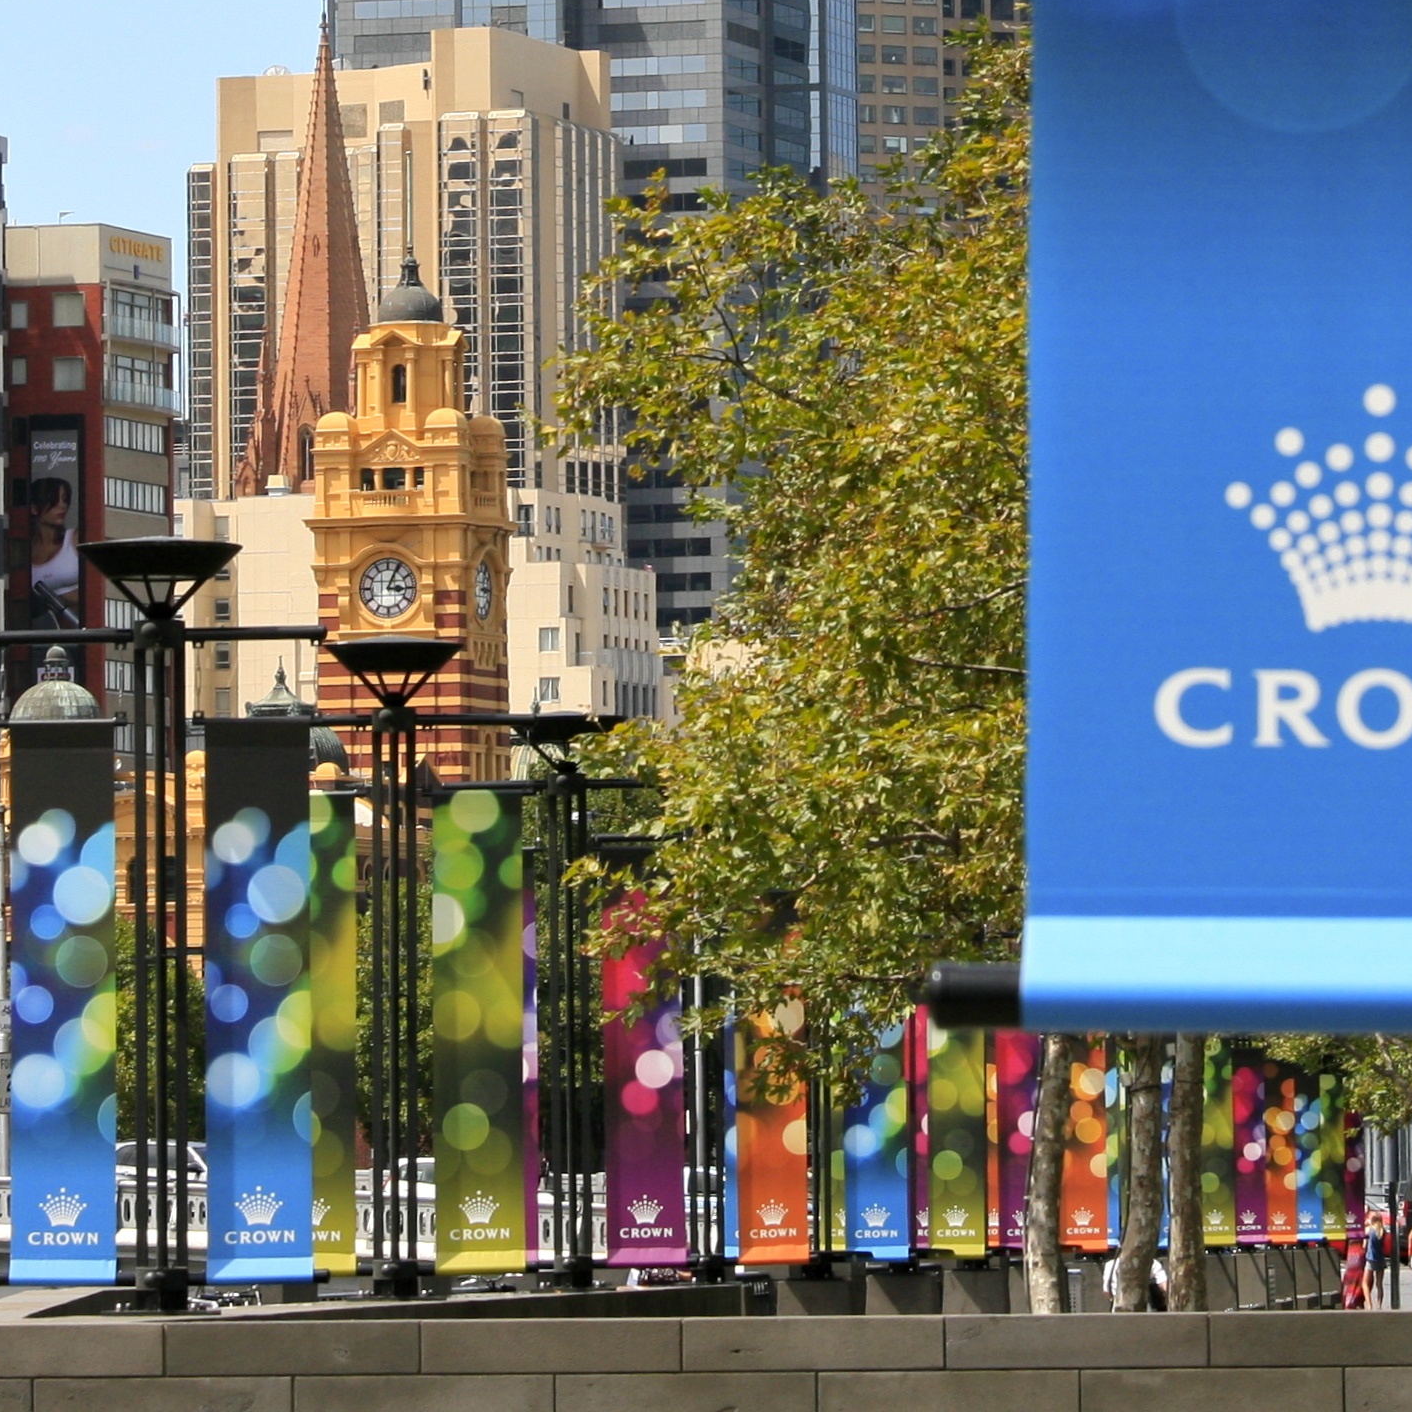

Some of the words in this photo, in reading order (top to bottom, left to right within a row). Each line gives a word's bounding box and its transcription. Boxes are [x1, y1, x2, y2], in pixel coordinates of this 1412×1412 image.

[33, 441, 77, 451] Celebrating
[224, 1230, 296, 1245] CROWN
[449, 1227, 511, 1241] CROWN
[619, 1227, 673, 1239] CROWN
[749, 1227, 797, 1239] CROWN
[854, 1229, 898, 1239] CROWN
[936, 1228, 976, 1237] CROWN
[1066, 1227, 1100, 1236] CROWN
[27, 1231, 99, 1246] CROWN
